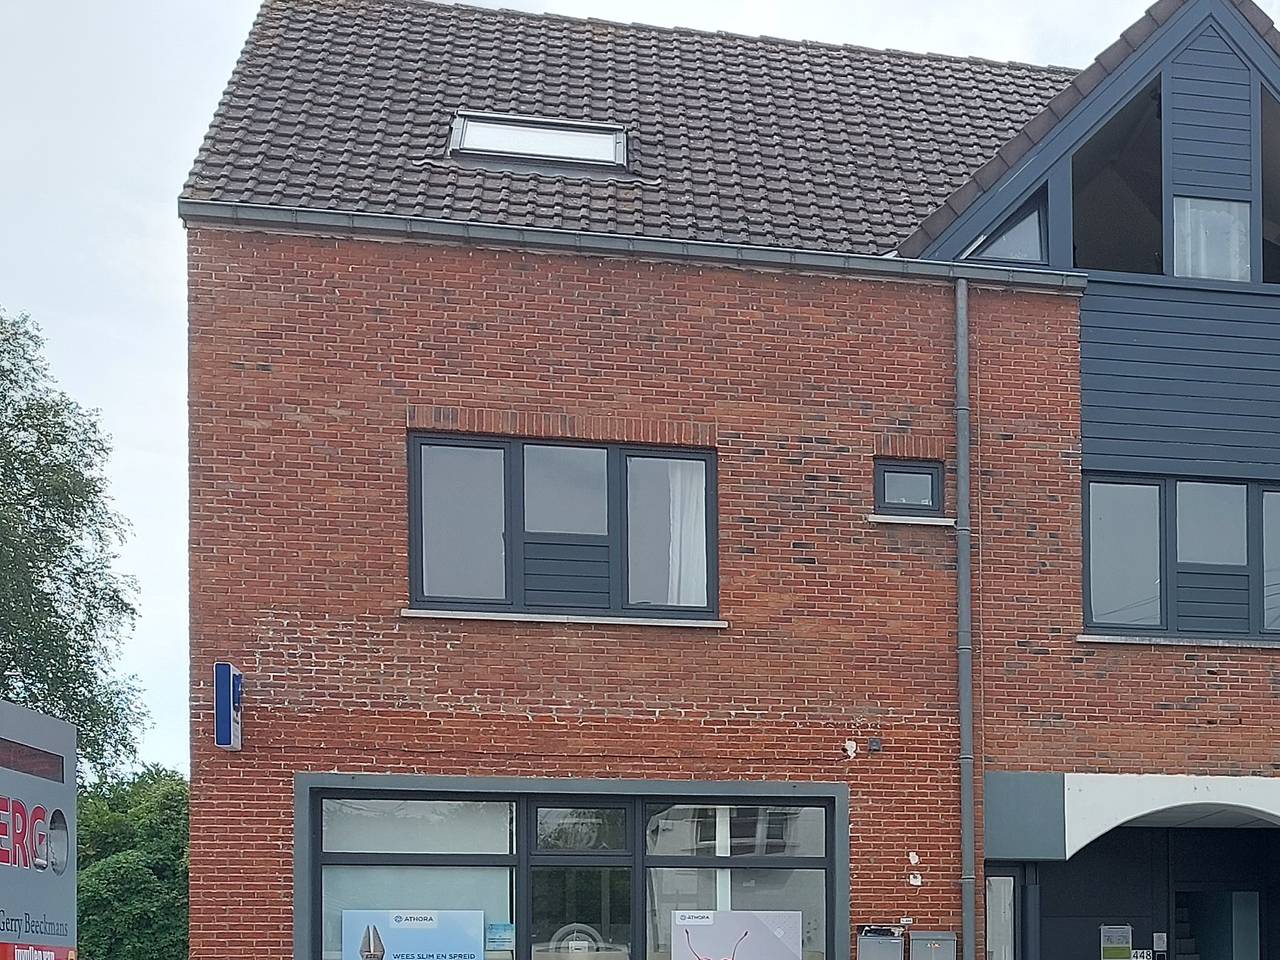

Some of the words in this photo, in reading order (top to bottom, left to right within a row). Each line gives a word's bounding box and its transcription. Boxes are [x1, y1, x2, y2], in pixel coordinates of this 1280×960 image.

[0, 909, 23, 939] Gerry
[24, 912, 69, 937] Beeckmans
[1132, 950, 1152, 960] 448
